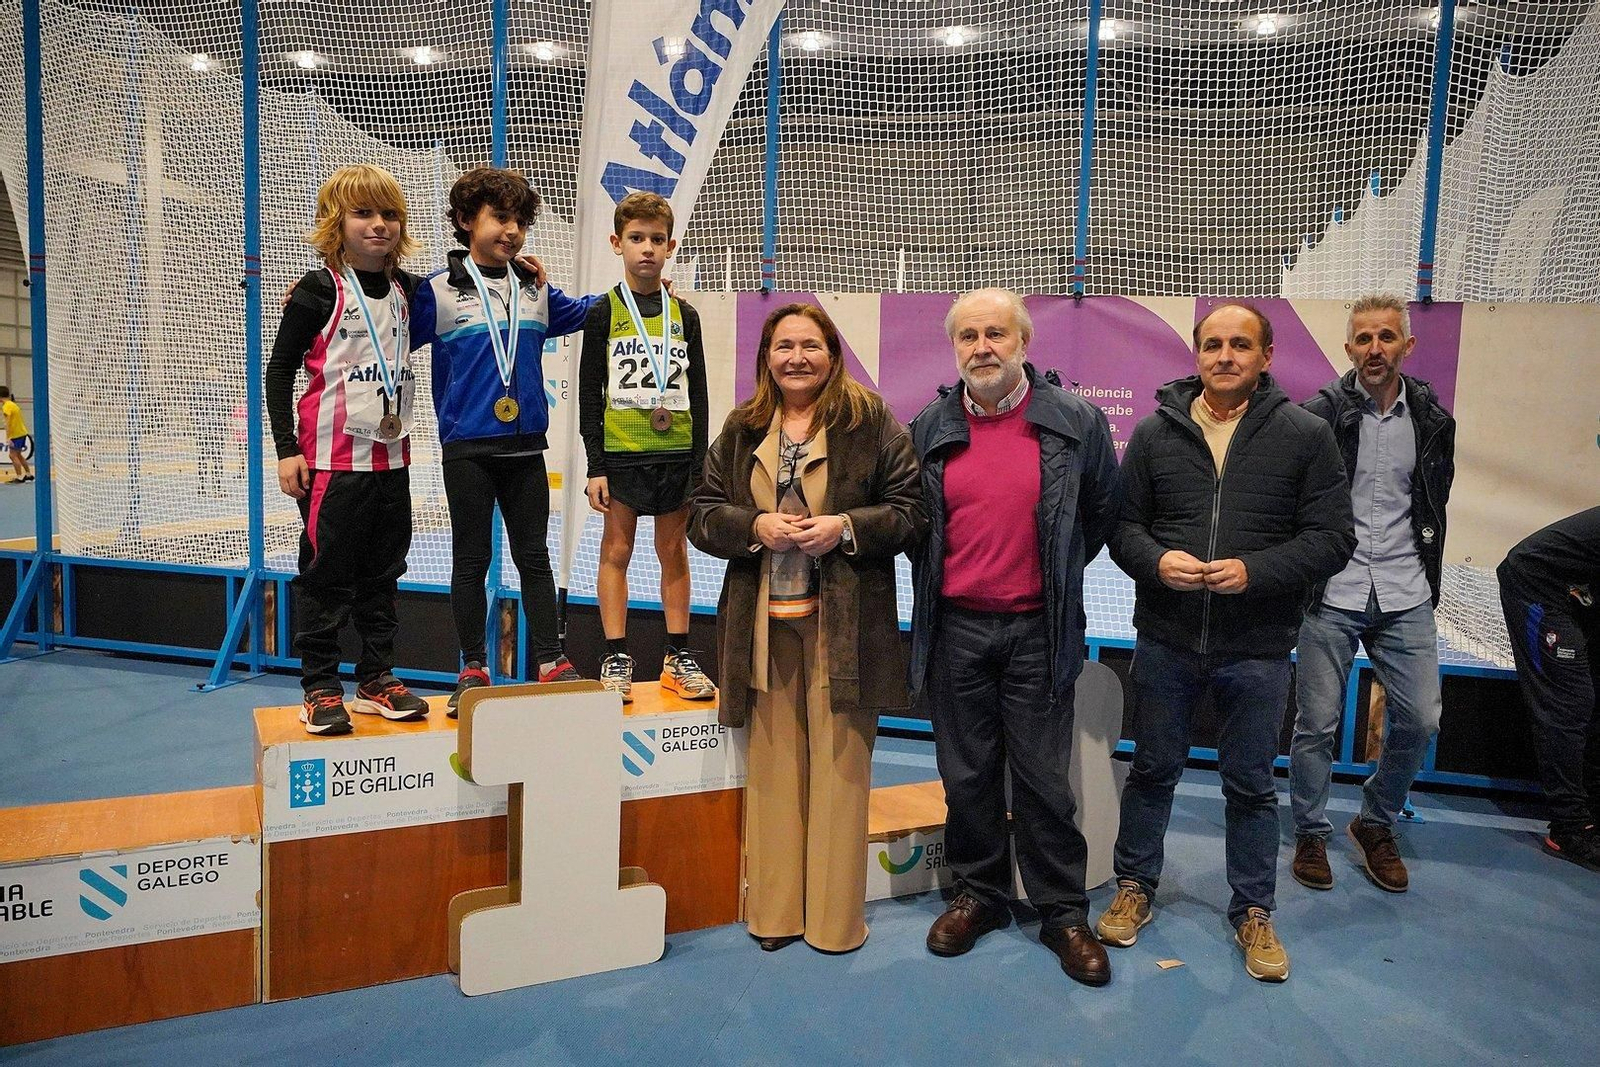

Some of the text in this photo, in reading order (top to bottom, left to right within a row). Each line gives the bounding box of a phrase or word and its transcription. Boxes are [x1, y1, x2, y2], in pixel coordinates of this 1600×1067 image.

[617, 357, 682, 390] 222
[662, 724, 726, 739] DEPORTE
[661, 737, 719, 753] GALEGO
[332, 756, 396, 777] XUNTA
[332, 772, 434, 797] DE GALICIA
[315, 822, 359, 833] Pontevedra
[445, 808, 485, 818] Pontevedra
[386, 808, 428, 818] Pontevedra
[137, 853, 229, 875] DEPORTE
[137, 870, 219, 891] GALEGO
[85, 926, 135, 939] Pontevedra
[156, 923, 205, 936] Pontevedra
